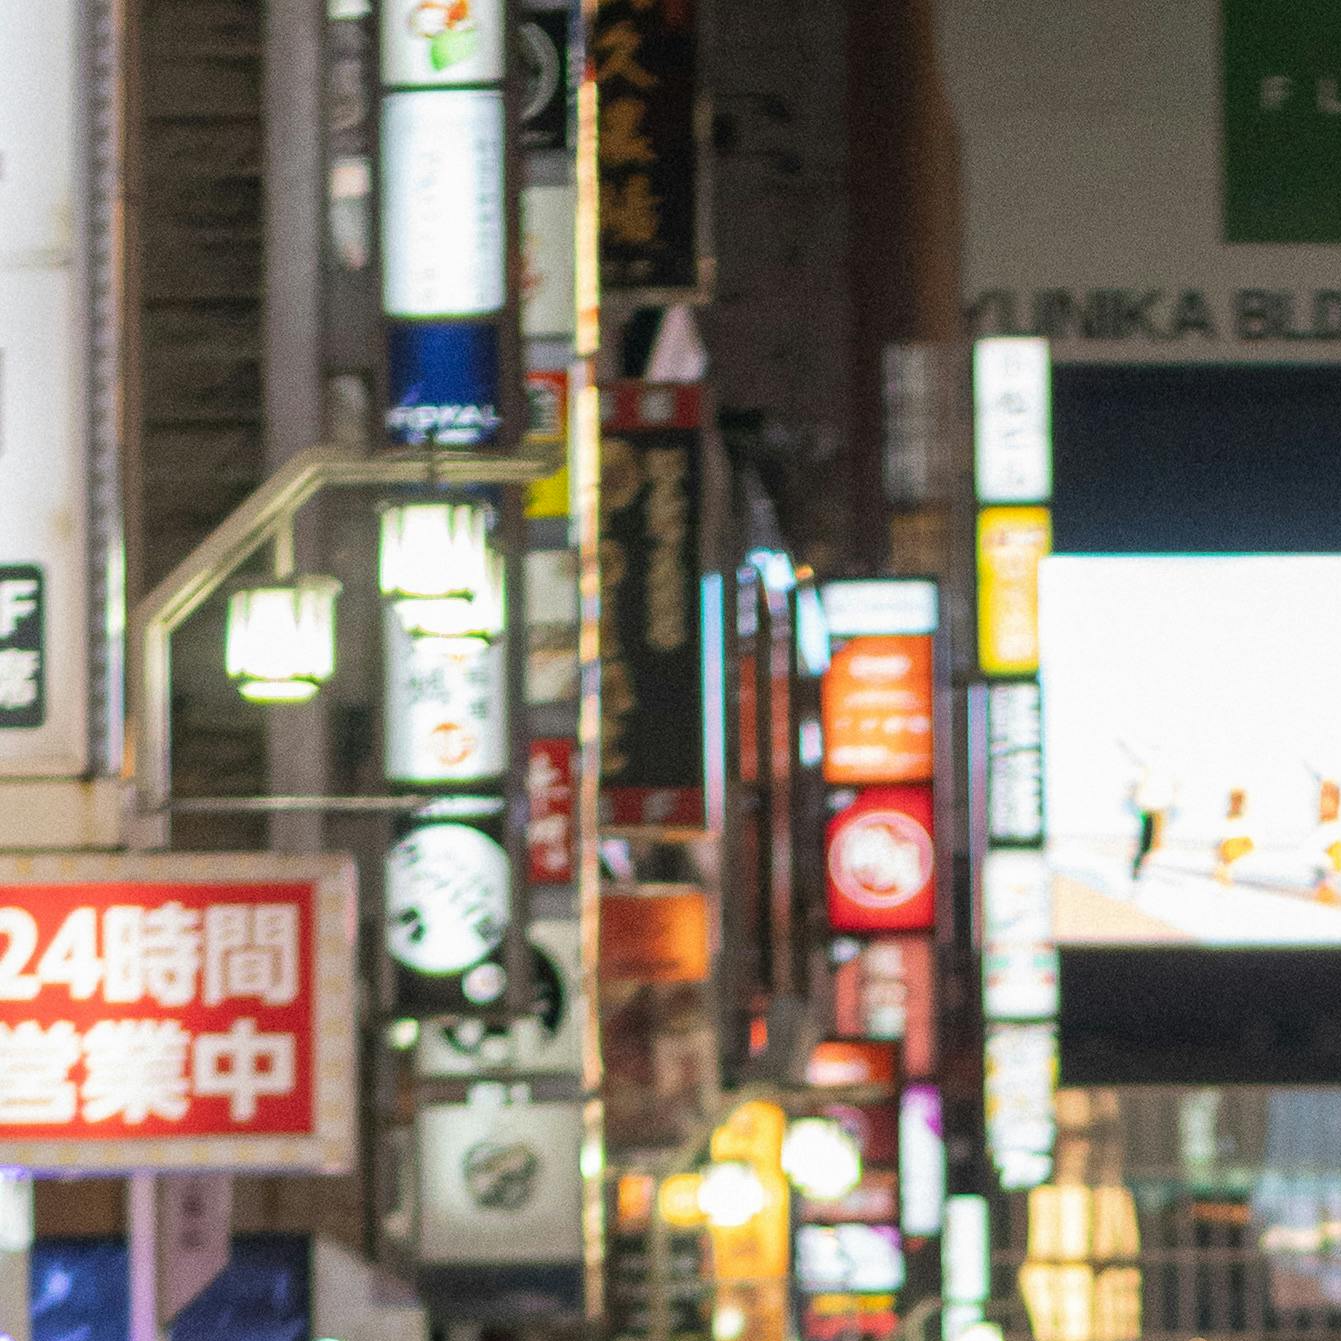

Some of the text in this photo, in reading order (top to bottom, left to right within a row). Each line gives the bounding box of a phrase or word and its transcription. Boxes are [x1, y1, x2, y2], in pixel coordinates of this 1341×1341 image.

[0, 900, 300, 1007] 24時間
[0, 1017, 299, 1126] 営業中
